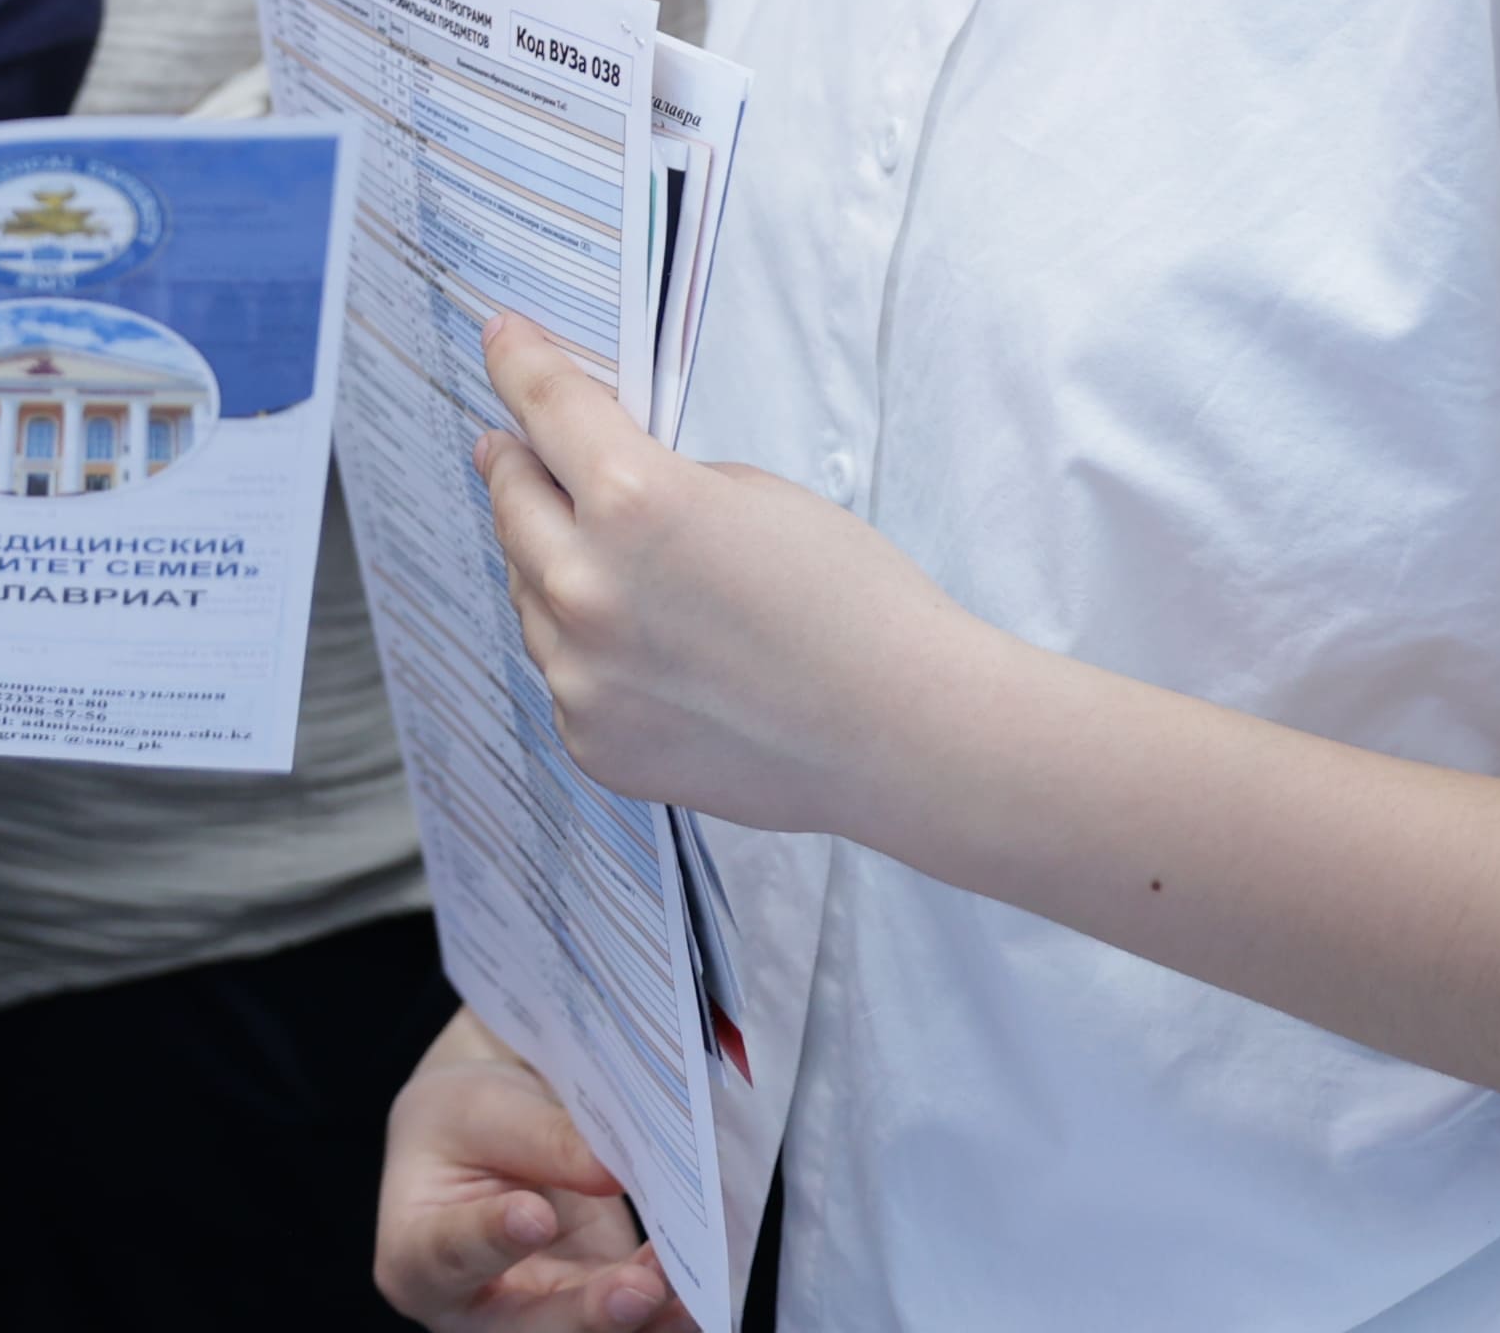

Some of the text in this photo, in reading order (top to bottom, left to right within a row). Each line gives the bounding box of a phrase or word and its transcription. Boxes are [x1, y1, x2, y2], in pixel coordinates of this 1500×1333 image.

[438, 16, 490, 49] ПРЕДМЕТОВ
[516, 25, 621, 88] Код ВУЗа 038
[652, 95, 702, 128] алавра
[105, 556, 260, 579] СЕМЕЙ»
[92, 687, 226, 701] поступления
